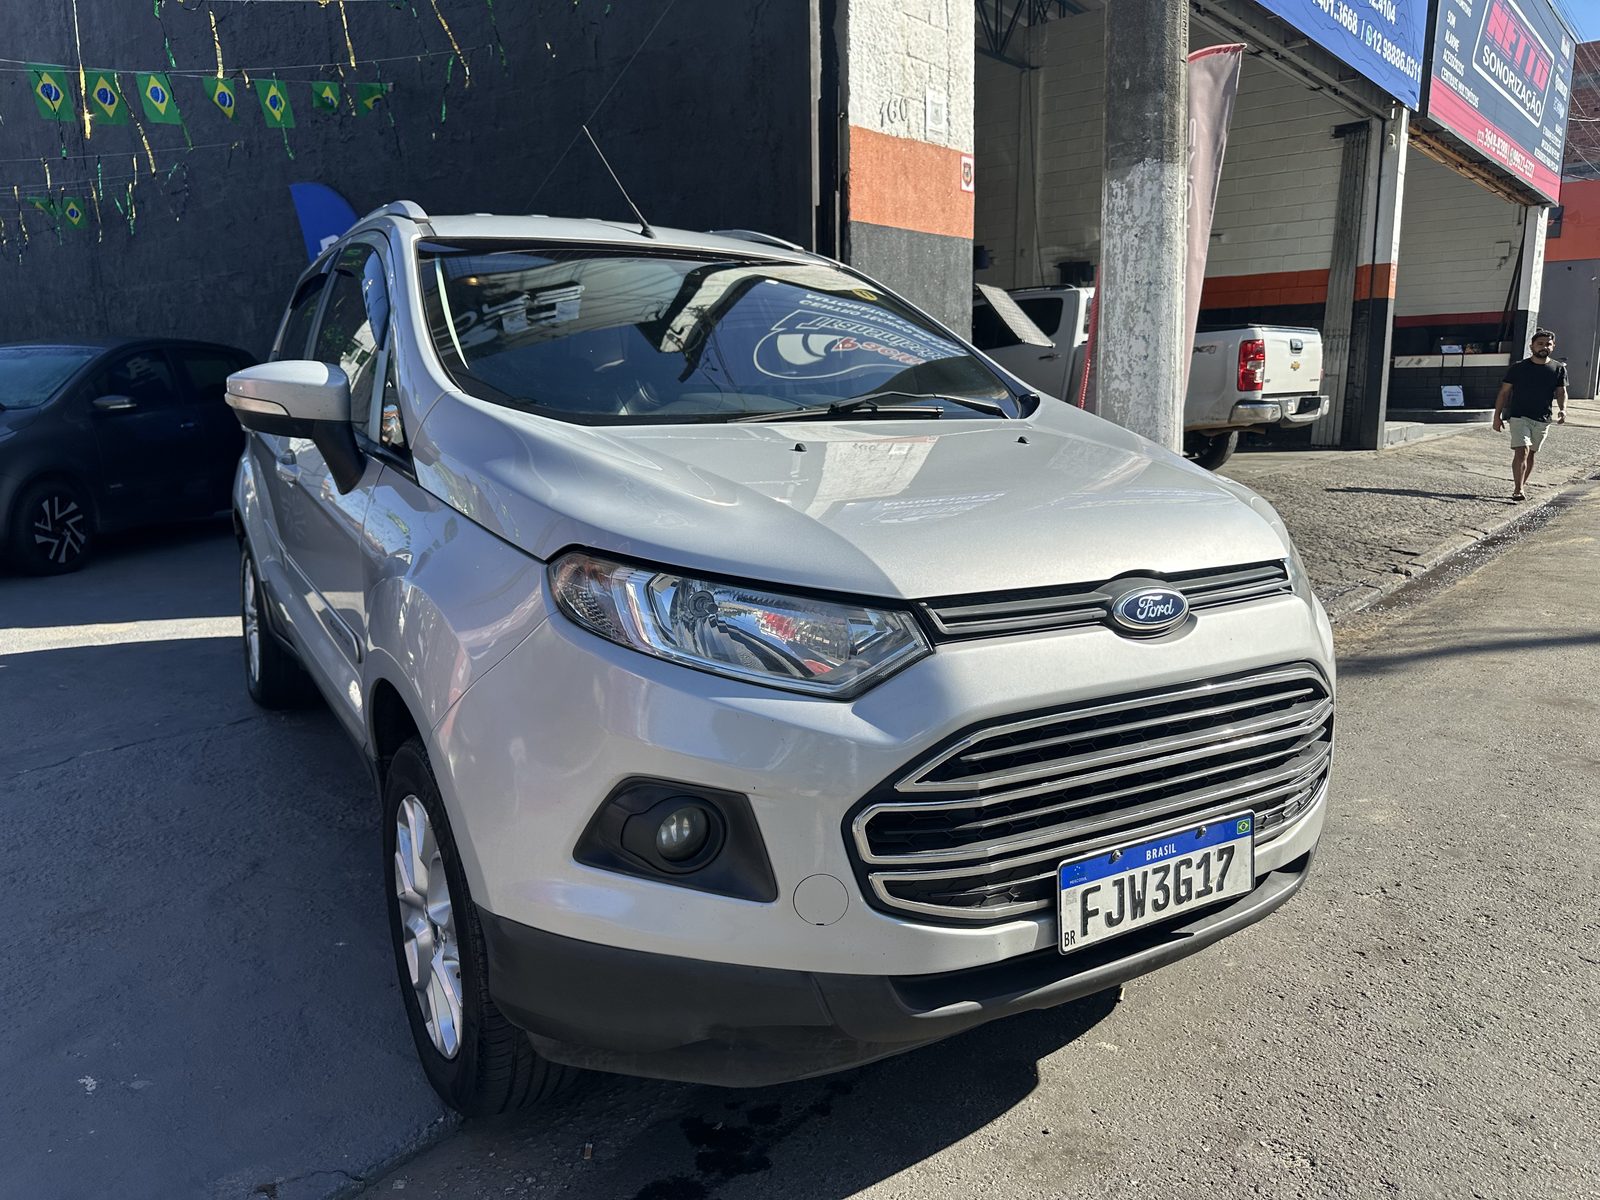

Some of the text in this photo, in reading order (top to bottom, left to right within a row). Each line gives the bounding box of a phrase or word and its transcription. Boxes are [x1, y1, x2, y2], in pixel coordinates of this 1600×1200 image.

[1369, 0, 1396, 25] 2.4104
[1313, 0, 1358, 35] 401.3668
[1373, 29, 1382, 54] 12
[1482, 45, 1542, 117] SONORIZAÇÃO
[1136, 594, 1175, 620] Ford
[1146, 843, 1177, 861] BRASIL
[1080, 844, 1235, 938] FJW3G17
[1064, 930, 1076, 947] BR
